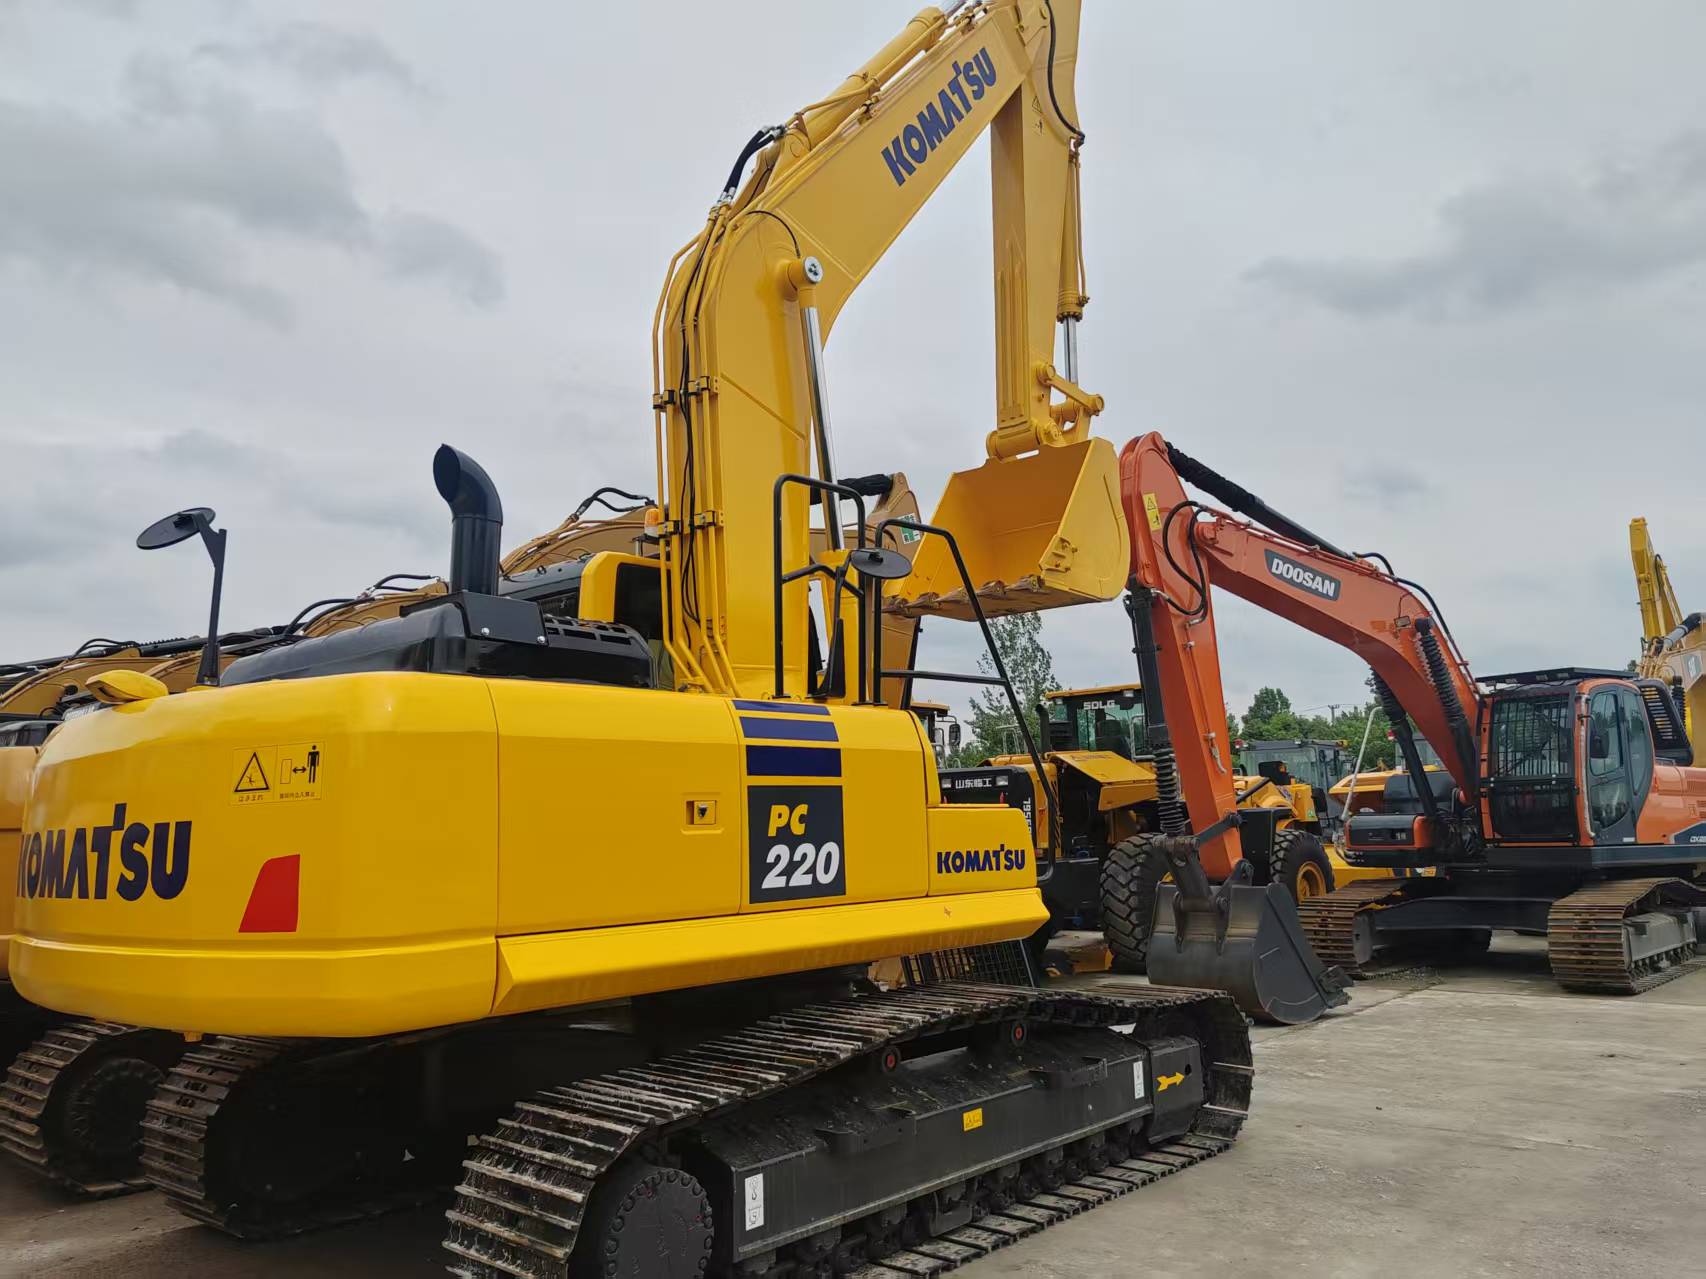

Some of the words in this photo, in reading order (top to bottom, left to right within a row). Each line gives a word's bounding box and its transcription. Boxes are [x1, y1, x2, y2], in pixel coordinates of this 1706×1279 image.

[881, 47, 997, 187] KOMATSU
[1271, 558, 1335, 597] DOOSAN
[1083, 700, 1116, 710] SDLG
[955, 778, 992, 789] 山东临工
[768, 804, 808, 837] PC
[17, 803, 192, 901] KOMATSU
[761, 841, 840, 889] 220
[937, 844, 1026, 874] KOMATSU
